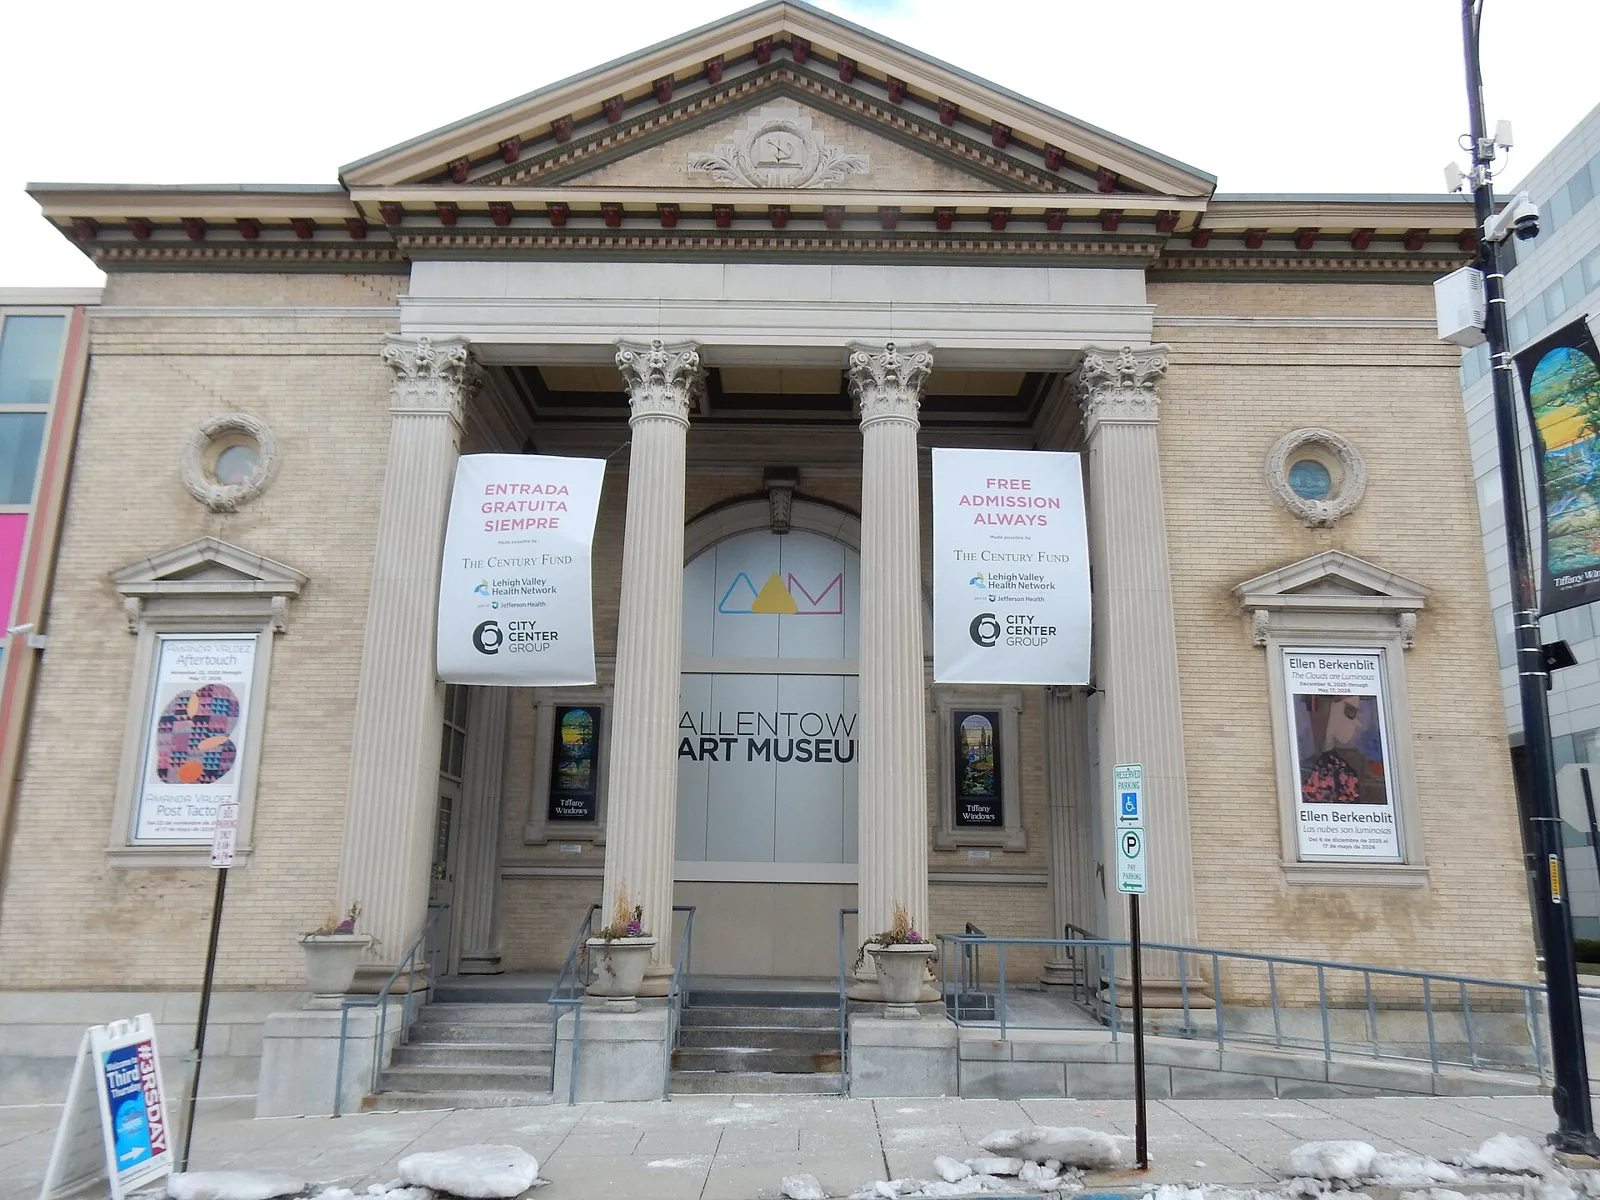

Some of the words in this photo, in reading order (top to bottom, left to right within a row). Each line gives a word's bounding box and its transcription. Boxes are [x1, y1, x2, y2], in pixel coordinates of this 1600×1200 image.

[484, 484, 569, 496] ENTRADA
[986, 478, 1032, 490] FREE
[481, 501, 568, 514] GRATUITA
[958, 495, 1060, 508] ADMISSION
[484, 518, 559, 532] SIEMPRE
[973, 513, 1048, 526] ALWAYS
[488, 557, 537, 568] CENTURY
[541, 554, 572, 565] FUND
[981, 550, 1033, 562] CENTURY
[1038, 552, 1069, 562] FUND
[492, 579, 520, 587] Lehigh
[521, 578, 546, 586] Valley
[988, 573, 1017, 582] Lehigh
[1018, 574, 1044, 582] Valley
[1554, 575, 1584, 586] Tiffany
[521, 586, 556, 594] Network
[508, 621, 536, 630] CITY
[1006, 615, 1034, 624] CITY
[1006, 626, 1056, 635] CENTER
[508, 632, 558, 642] CENTER
[1006, 637, 1048, 646] GROUP
[508, 642, 550, 653] GROUP
[176, 654, 237, 667] Aftertouch
[1290, 659, 1316, 669] Ellen
[1319, 659, 1374, 670] Berkenblit
[678, 711, 857, 737] ALLENTOW
[678, 737, 738, 761] ART
[747, 738, 859, 763] MUSEU
[560, 799, 584, 807] Tiffany
[156, 805, 181, 816] Post
[186, 804, 217, 816] Tacto
[1300, 811, 1328, 822] Ellen
[1332, 812, 1393, 823] Berkenblit
[1355, 826, 1392, 834] luminosas
[1127, 836, 1136, 853] P
[106, 1064, 140, 1088] Third
[137, 1045, 166, 1150] #3RSDAY
